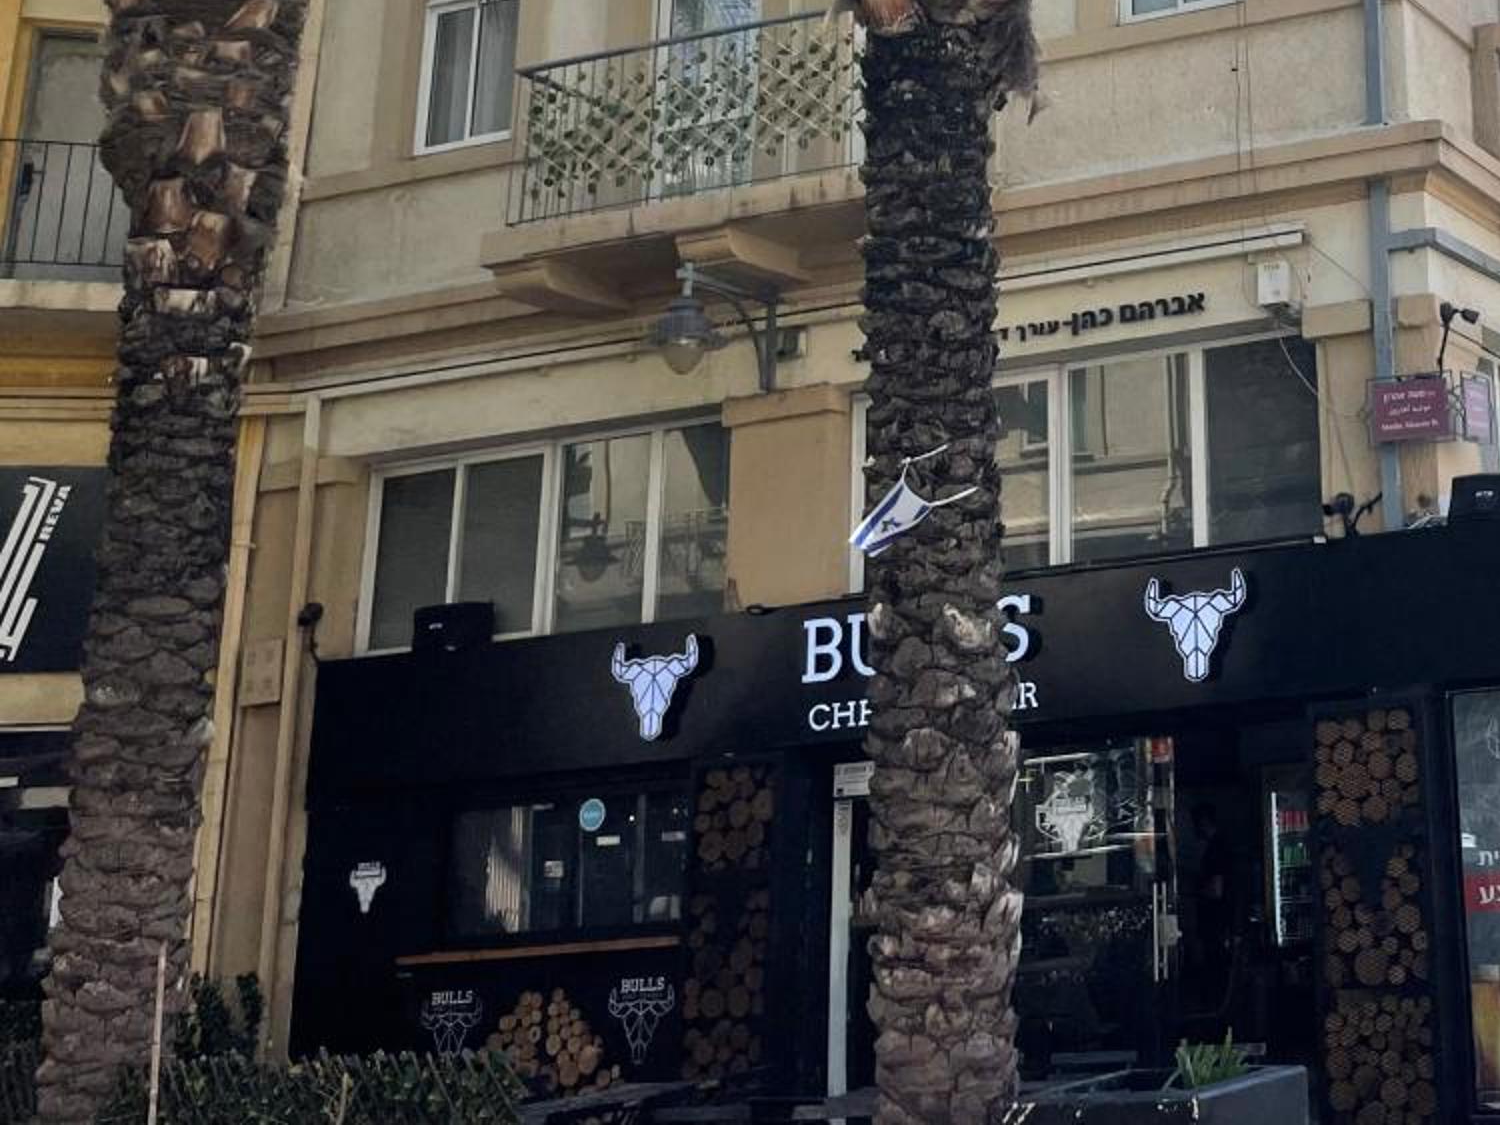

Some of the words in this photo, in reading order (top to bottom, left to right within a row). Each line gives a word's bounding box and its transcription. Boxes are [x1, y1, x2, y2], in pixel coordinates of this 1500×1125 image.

[1119, 291, 1206, 325] אברהם
[620, 976, 666, 993] BULLS
[431, 990, 474, 1006] BULLS
